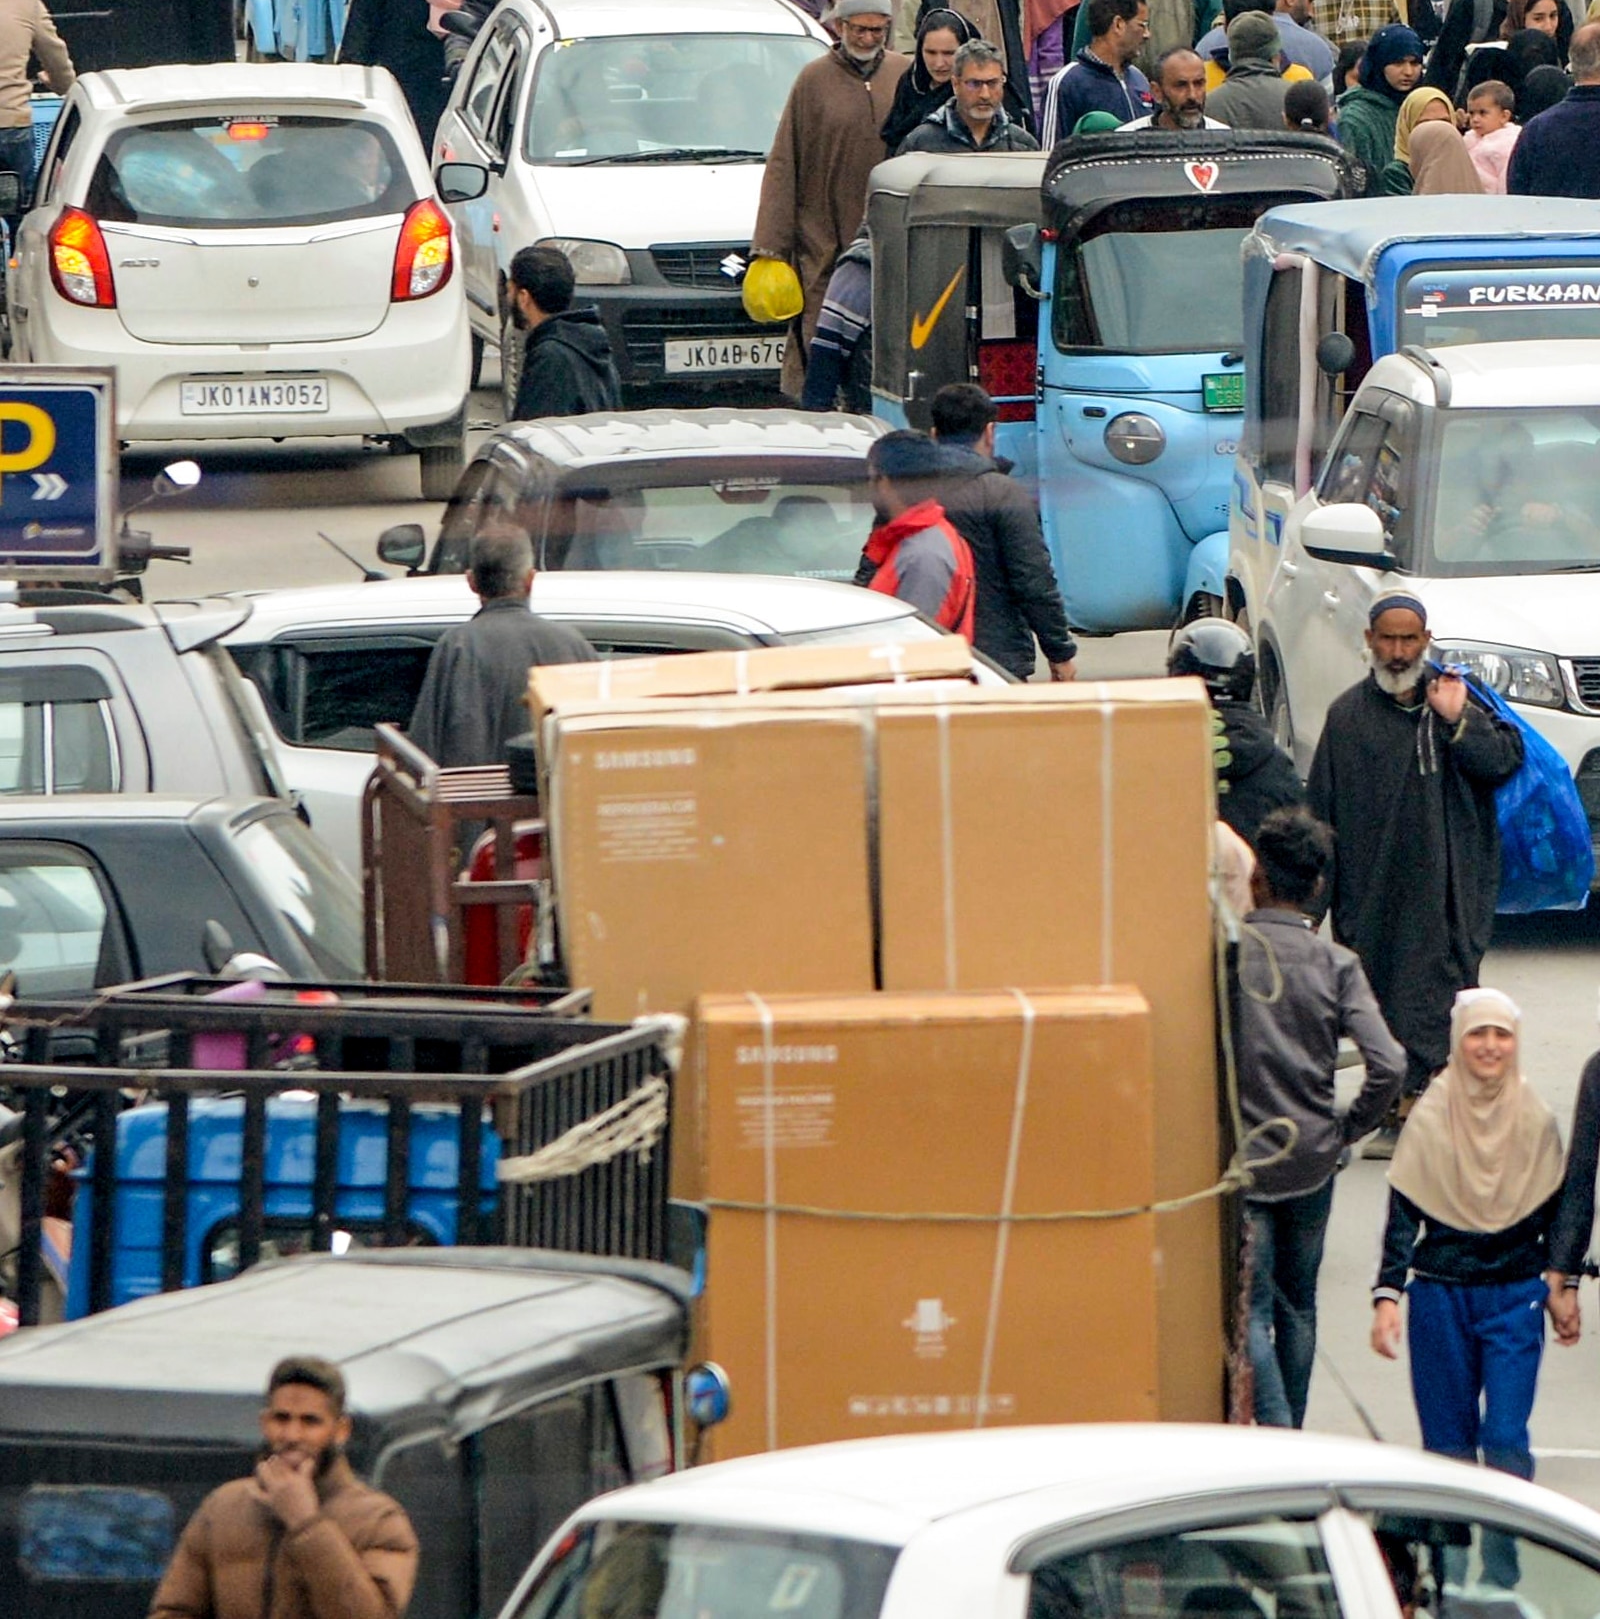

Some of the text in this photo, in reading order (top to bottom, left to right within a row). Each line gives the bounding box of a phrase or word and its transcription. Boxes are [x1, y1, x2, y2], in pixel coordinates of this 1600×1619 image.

[195, 385, 324, 408] JK01AN3052
[594, 747, 696, 770] SAMSUNG
[736, 1044, 838, 1066] SAMSUNG
